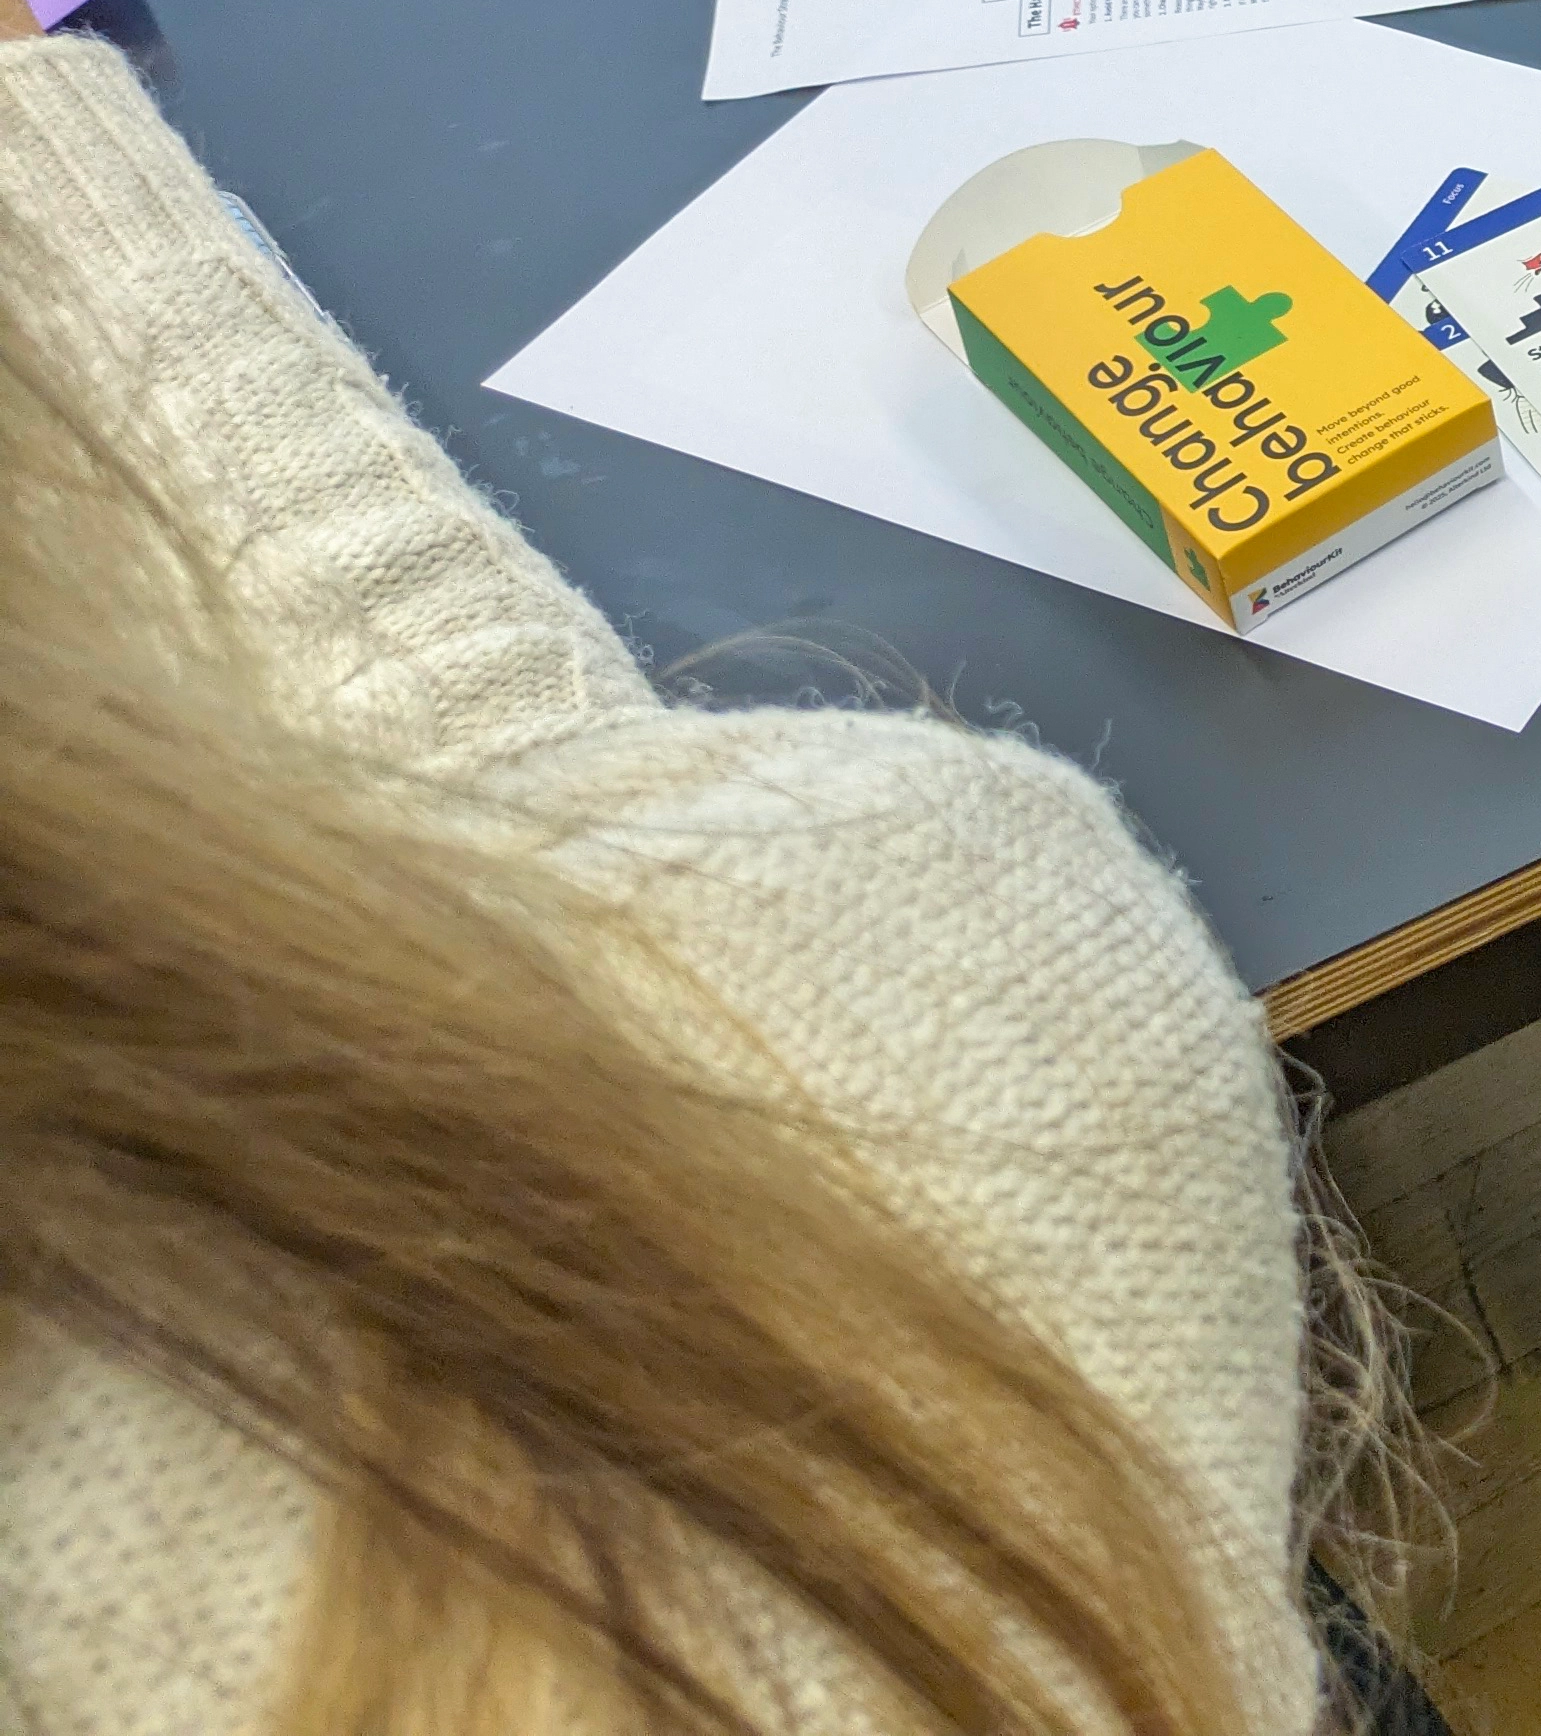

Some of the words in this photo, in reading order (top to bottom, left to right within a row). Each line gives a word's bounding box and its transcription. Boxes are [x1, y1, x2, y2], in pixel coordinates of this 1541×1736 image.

[1026, 9, 1042, 29] The
[1442, 182, 1465, 205] Focus
[1422, 241, 1454, 262] 11
[1441, 324, 1462, 340] 2
[1094, 275, 1343, 502] behaviour
[1315, 412, 1348, 436] Move
[1346, 390, 1391, 418] beyond
[1391, 374, 1421, 395] good
[1086, 354, 1271, 533] Change
[1324, 411, 1386, 445] intentions.
[1336, 430, 1378, 454] Create
[1373, 398, 1430, 432] behaviour
[1346, 438, 1391, 465] change
[1388, 422, 1414, 440] that
[1413, 405, 1450, 425] sticks.
[1272, 547, 1342, 593] BehaviourKit
